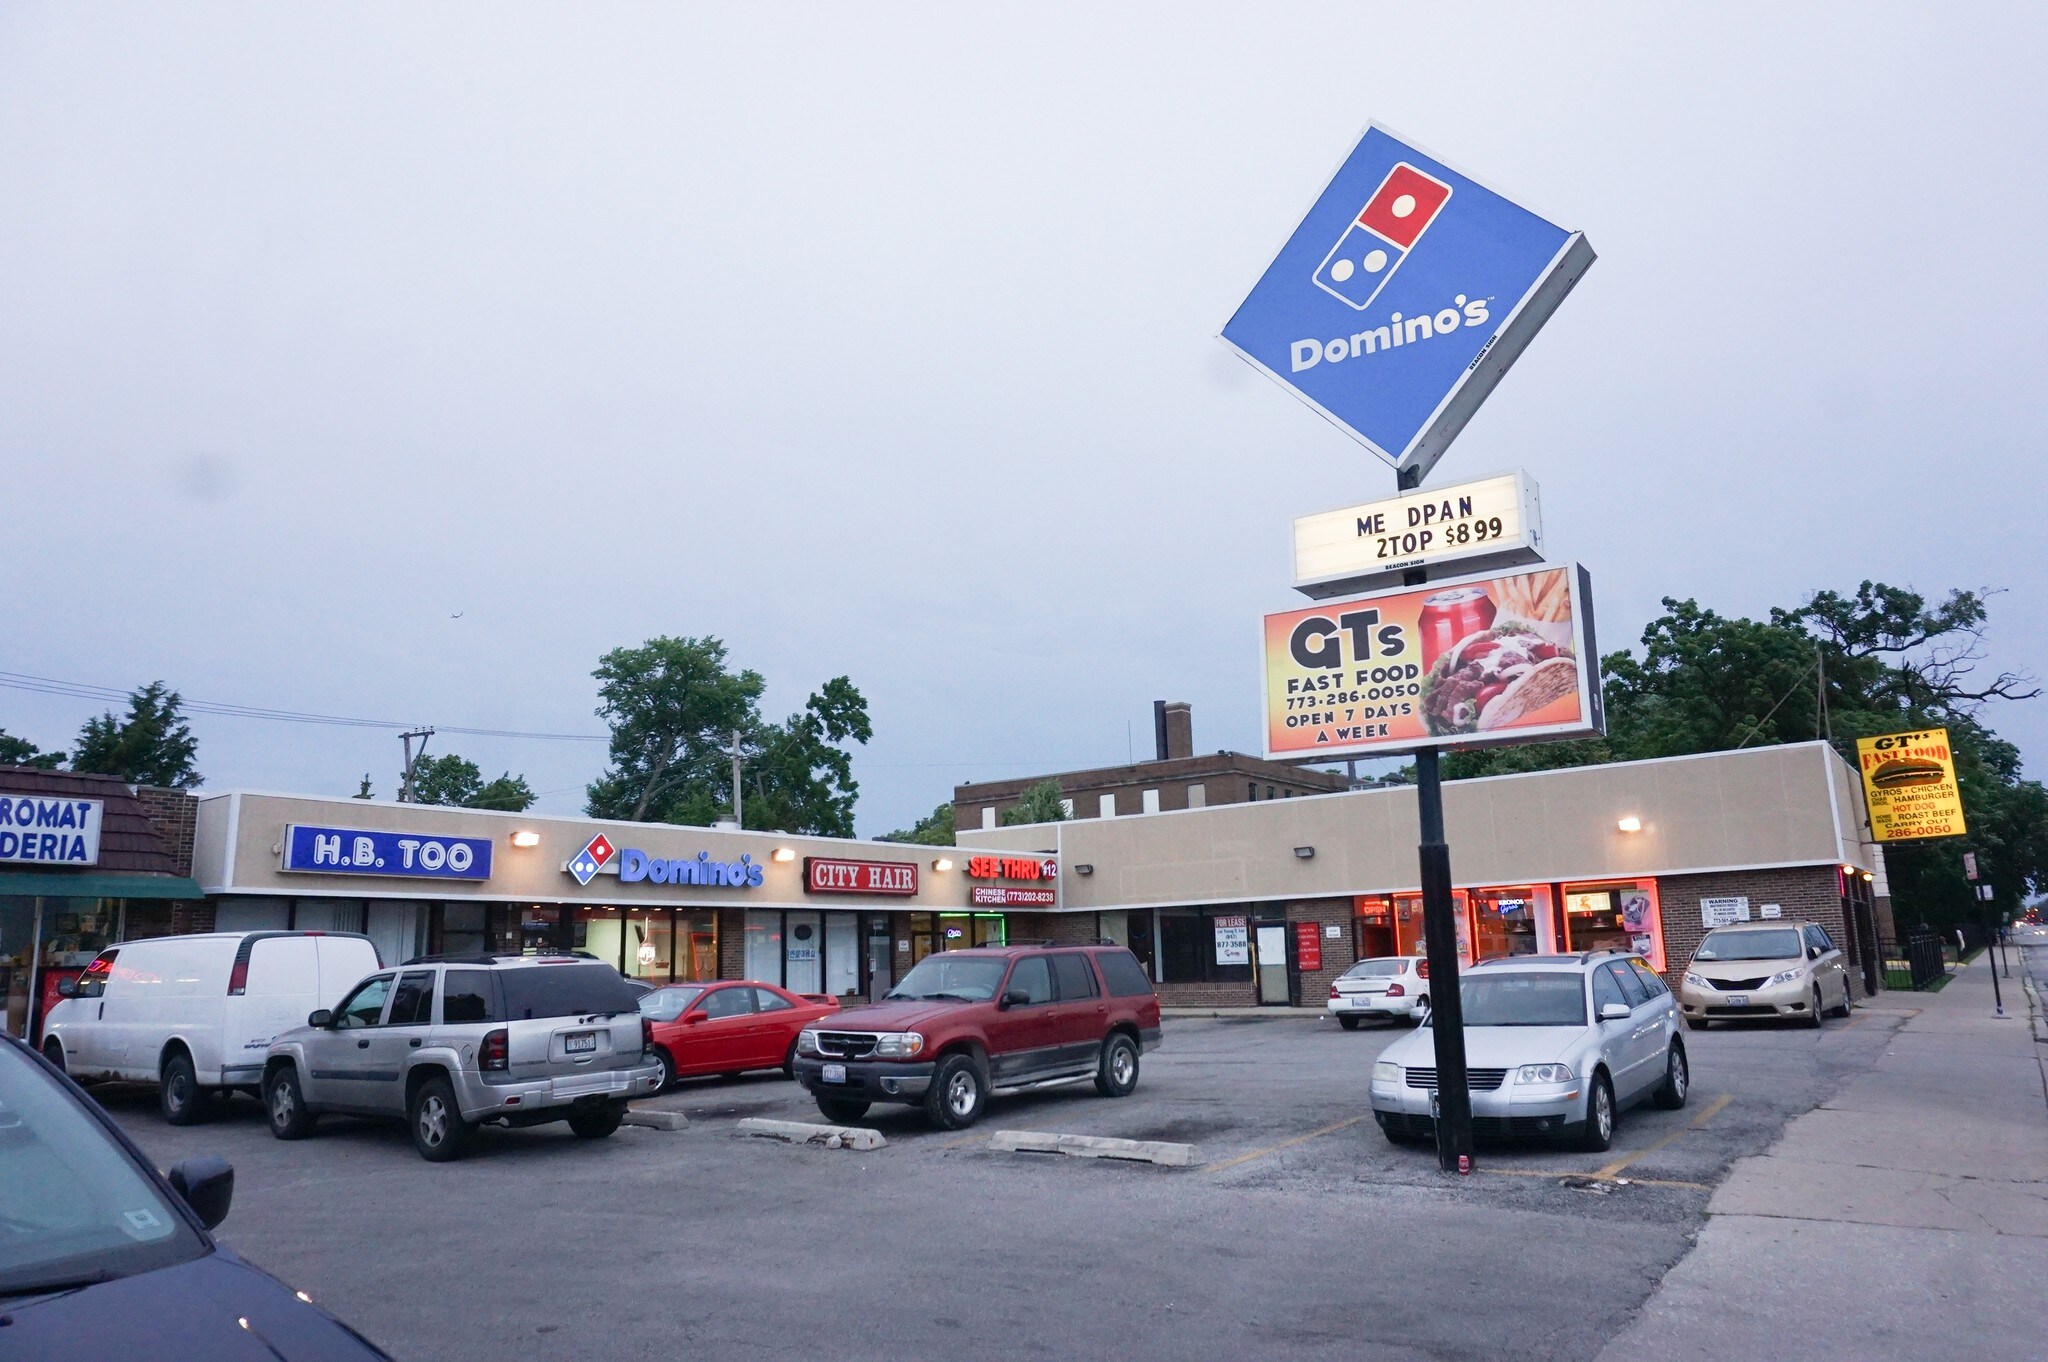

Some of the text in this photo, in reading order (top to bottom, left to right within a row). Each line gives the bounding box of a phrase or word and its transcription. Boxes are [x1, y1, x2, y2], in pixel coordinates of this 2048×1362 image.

[1291, 294, 1490, 372] Domino's
[1469, 334, 1497, 370] BEACON SIGN
[1357, 513, 1385, 537] ME
[1385, 559, 1424, 570] BEACON SIGN
[1288, 664, 1419, 694] FAST FOOD
[1286, 703, 1411, 728] OPEN 7 DAYS
[1317, 724, 1388, 742] A WEEK
[1862, 745, 1948, 770] FAST FOOD
[1870, 783, 1953, 797] GYROS CHICKEN
[1894, 791, 1955, 803] HAMBURGER
[0, 798, 91, 829] ROMAT
[1893, 802, 1936, 813] HOT DOG
[1898, 808, 1957, 820] ROAST BEEF
[1885, 821, 1923, 829] CARRY
[1887, 824, 1951, 838] 286-0050
[0, 832, 87, 861] DERIA
[314, 834, 473, 872] H.B. TOO
[620, 848, 764, 887] Domino's
[815, 864, 914, 889] CITY HAIR
[970, 856, 999, 878] SEE
[1002, 859, 1040, 880] THRU
[975, 888, 1006, 896] CHINESE
[975, 895, 1006, 903] KITCHEN
[1006, 891, 1054, 903] (773)202-8238
[1216, 917, 1245, 927] FOR LEASE
